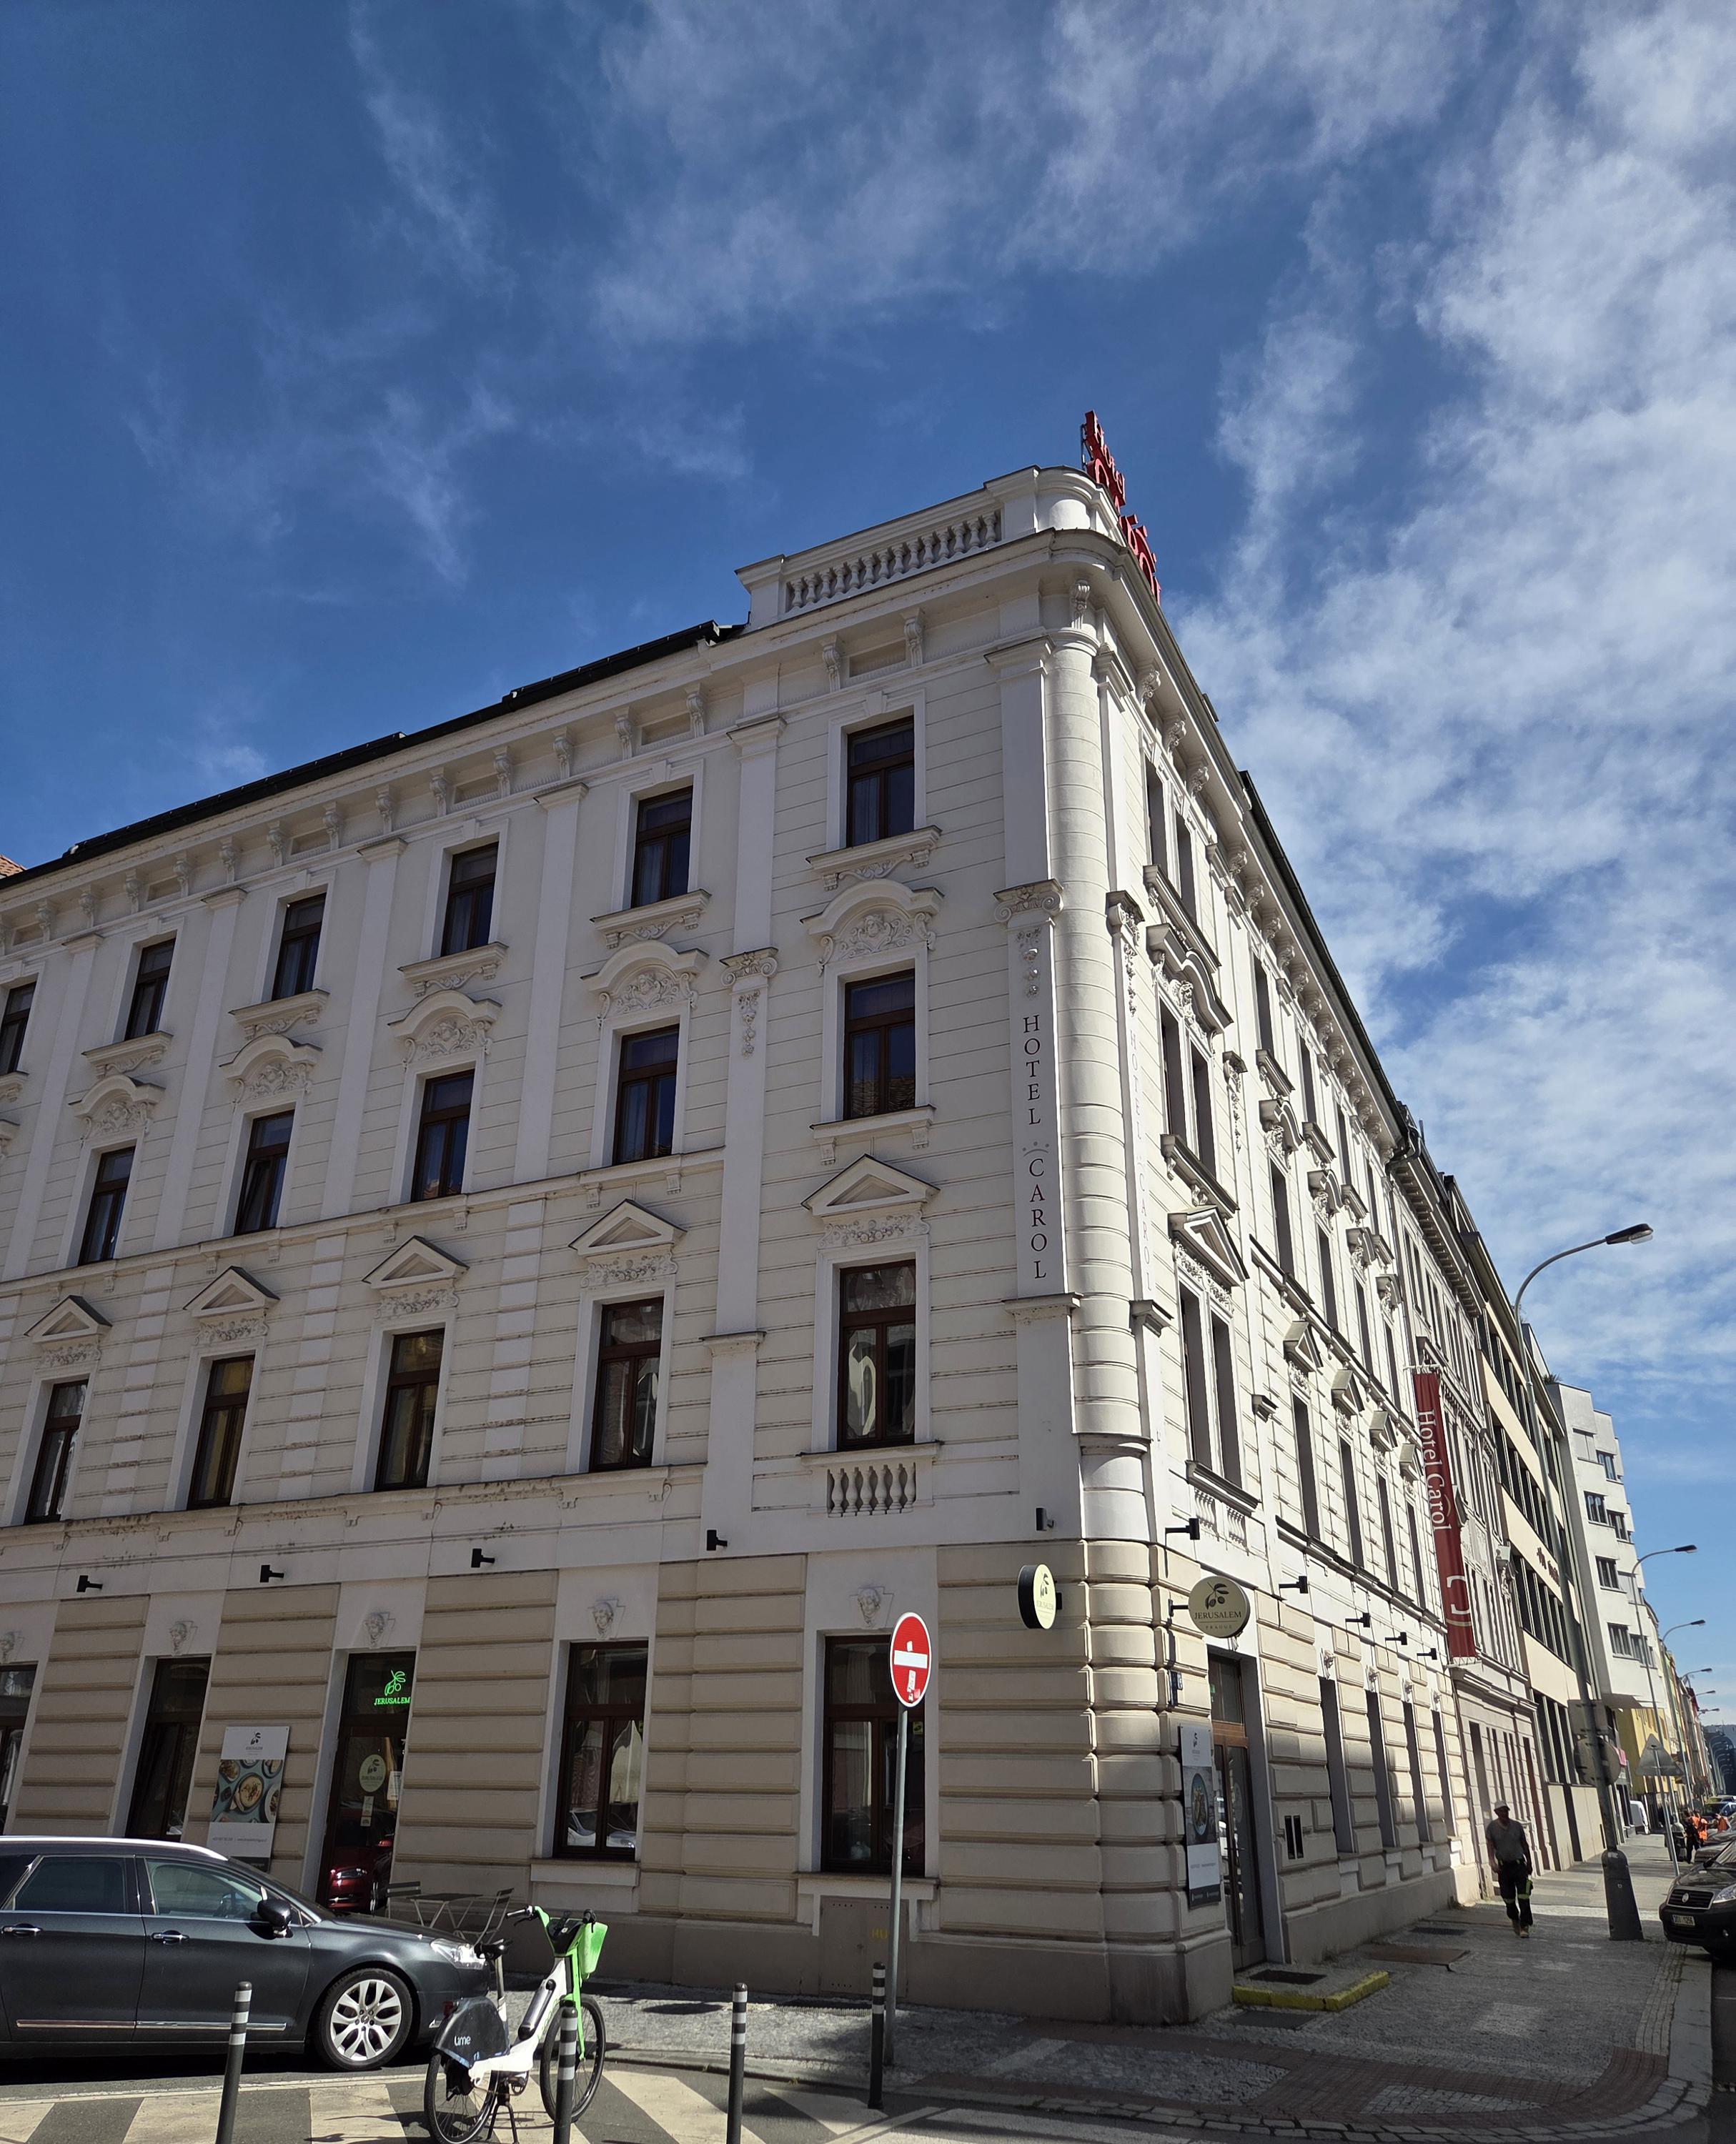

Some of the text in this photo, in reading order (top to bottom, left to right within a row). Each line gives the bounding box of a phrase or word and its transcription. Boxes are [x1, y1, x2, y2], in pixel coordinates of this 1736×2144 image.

[1023, 1015, 1041, 1126] HOTEL
[1028, 1158, 1048, 1280] CAROL
[1417, 1409, 1452, 1532] Hotel Carol
[1194, 1611, 1242, 1619] JERUSALEM
[374, 1697, 411, 1706] JERUSALEM
[454, 2035, 471, 2047] Lime
